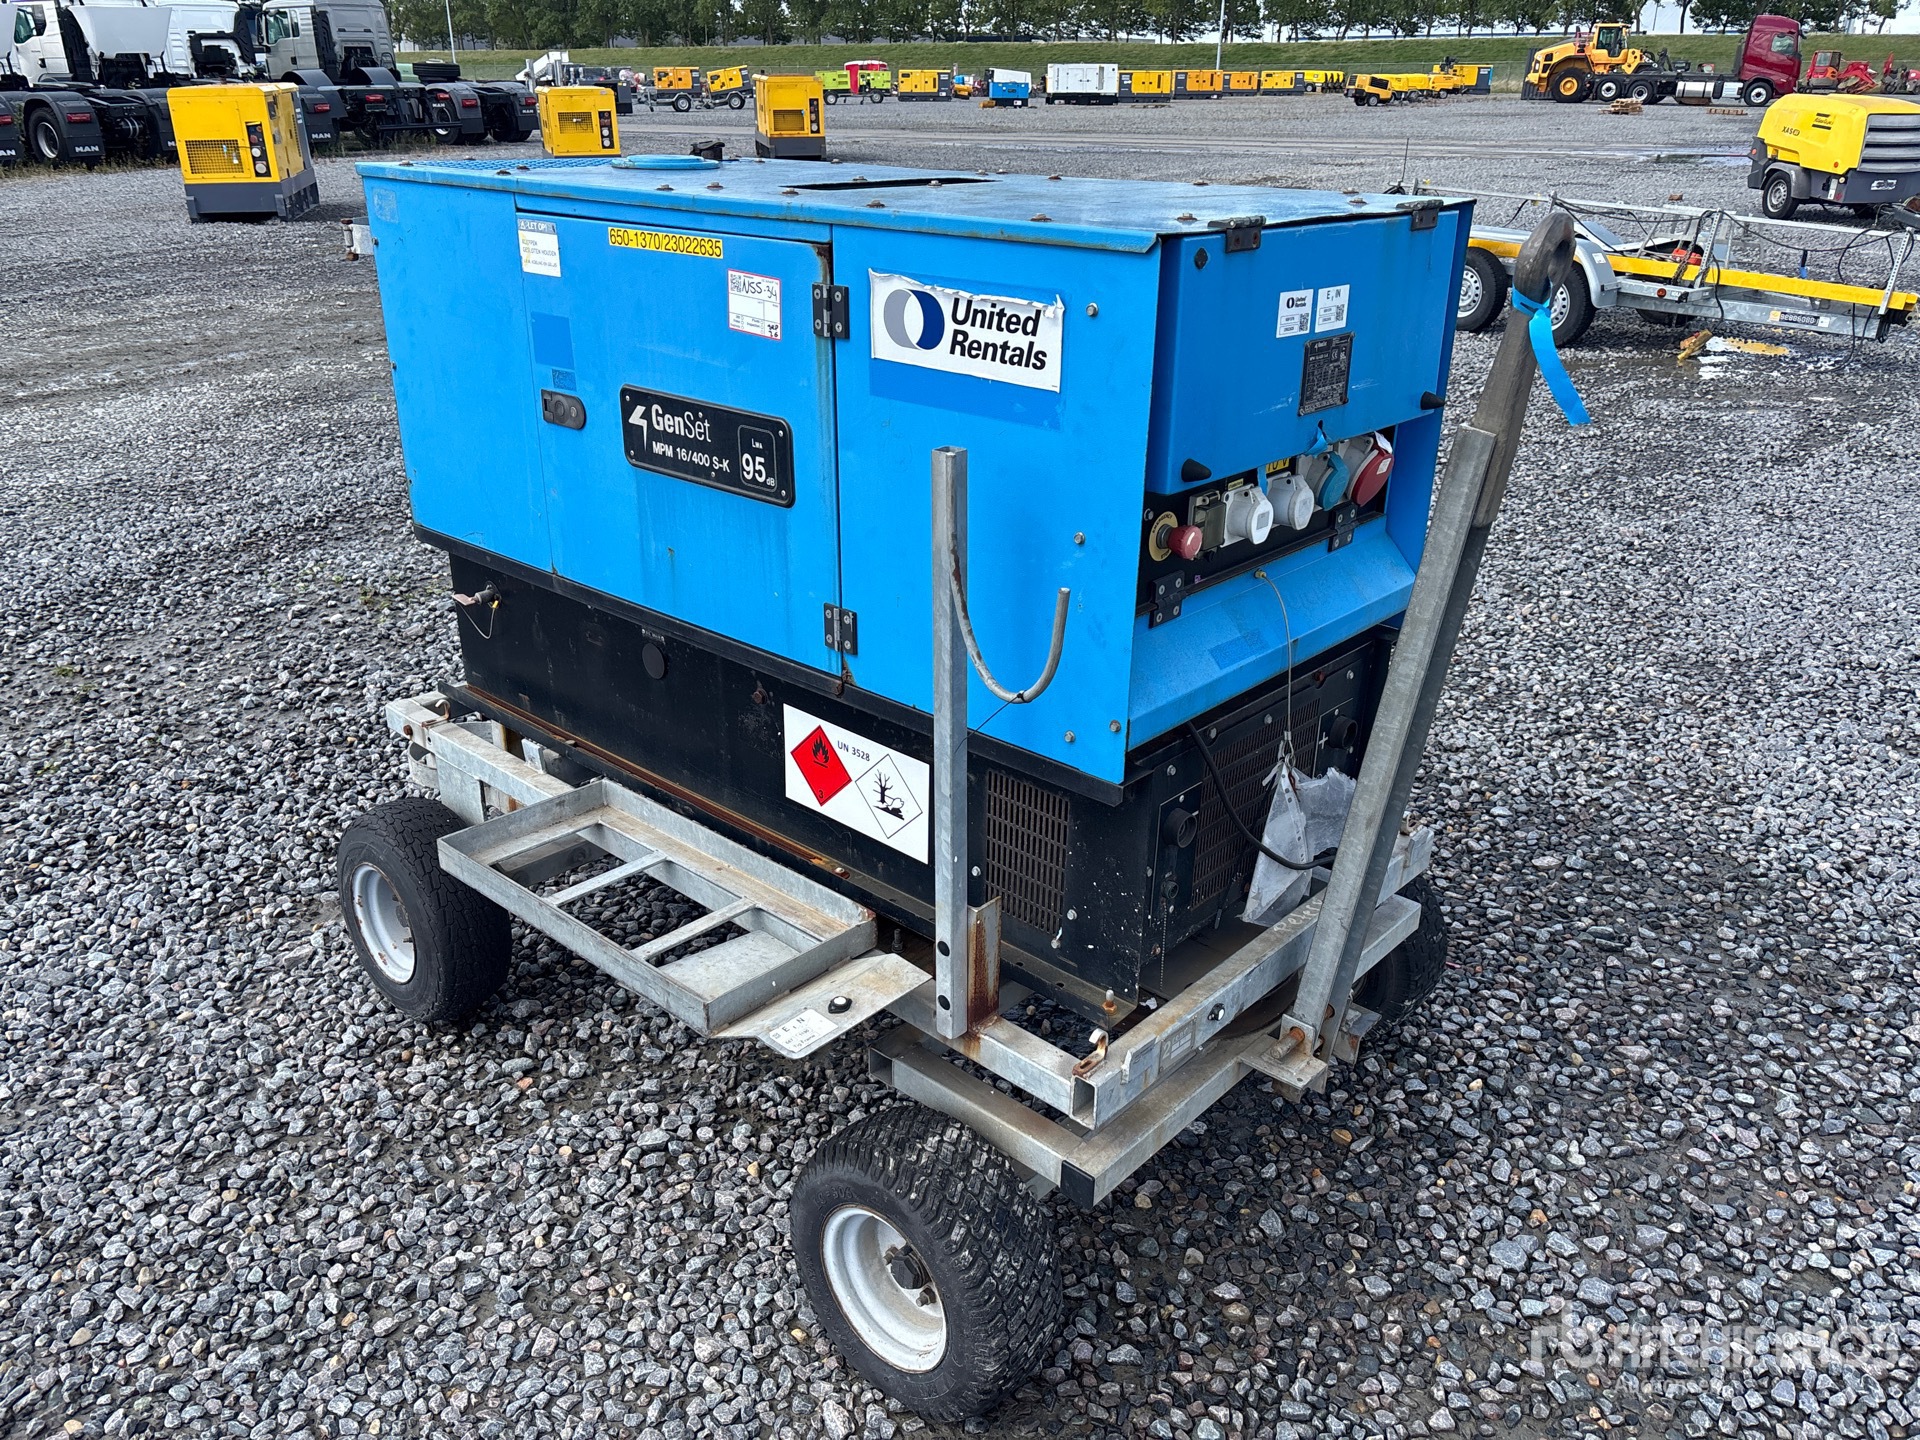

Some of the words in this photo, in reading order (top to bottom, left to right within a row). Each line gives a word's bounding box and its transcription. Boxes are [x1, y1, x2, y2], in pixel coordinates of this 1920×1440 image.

[75, 145, 99, 153] MAN
[609, 228, 722, 257] 650-1370/23022635
[951, 297, 1042, 337] United
[949, 329, 1047, 370] Rentals
[651, 404, 711, 443] GenSet
[652, 441, 673, 458] MPM
[676, 447, 710, 467] 16/400
[712, 456, 730, 473] S-K
[742, 453, 766, 483] 95
[837, 740, 850, 753] UN
[851, 746, 870, 762] 3528
[818, 790, 824, 799] 3
